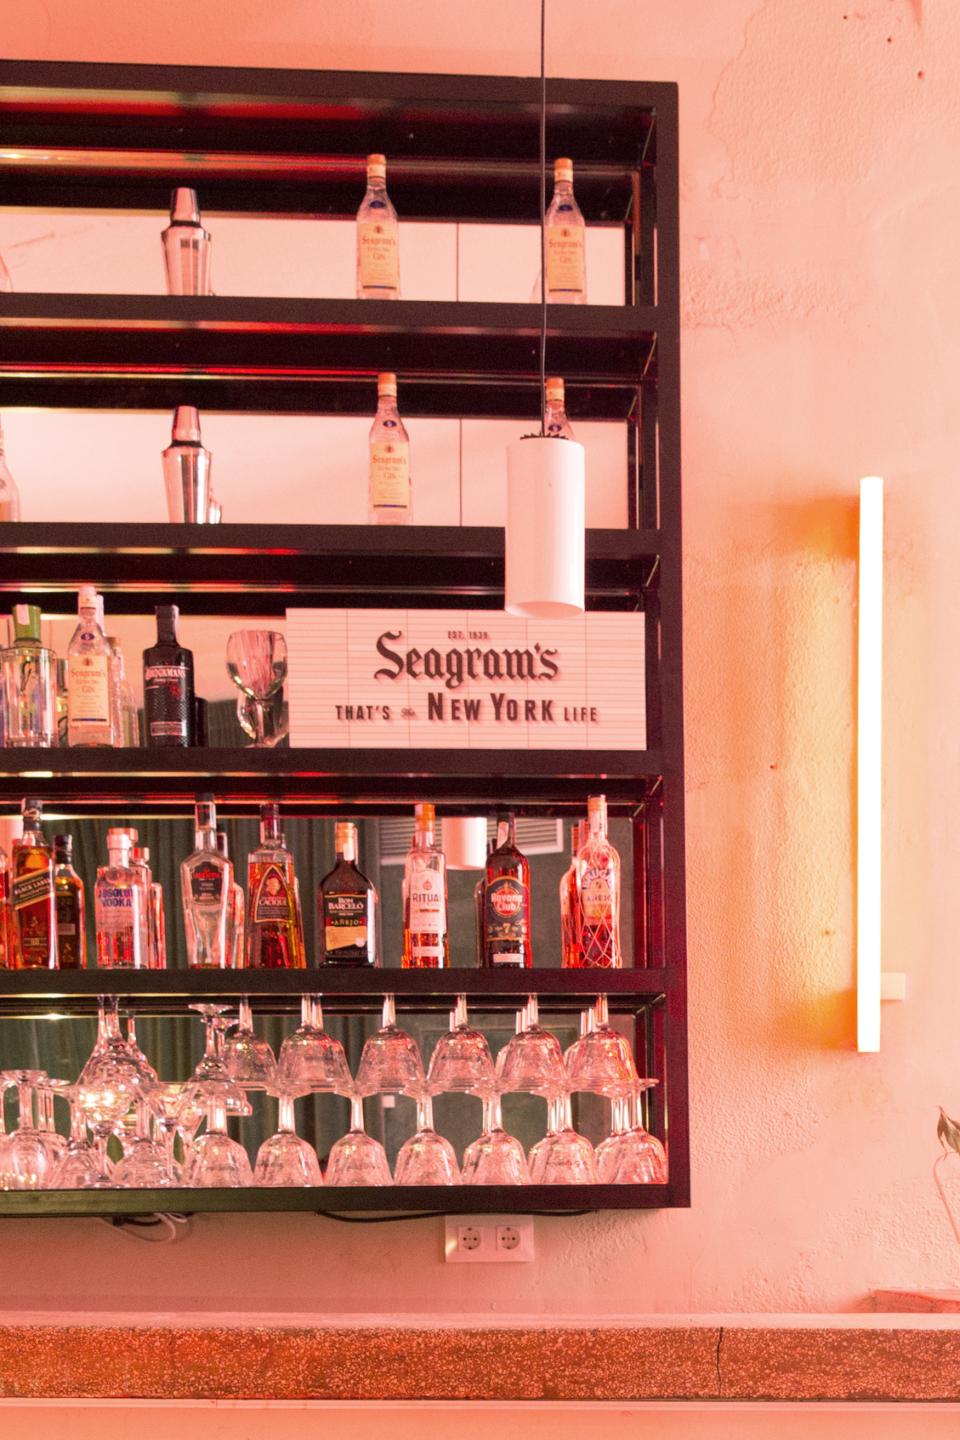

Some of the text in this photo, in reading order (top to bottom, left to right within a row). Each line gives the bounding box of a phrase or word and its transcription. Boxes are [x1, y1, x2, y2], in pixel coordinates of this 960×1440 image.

[373, 630, 559, 689] Seagram's
[335, 704, 391, 721] THAT'S
[427, 692, 481, 721] NEW
[490, 692, 554, 722] YORK
[563, 706, 598, 722] LIFE
[101, 898, 133, 908] VODKA
[412, 893, 443, 903] RITUA
